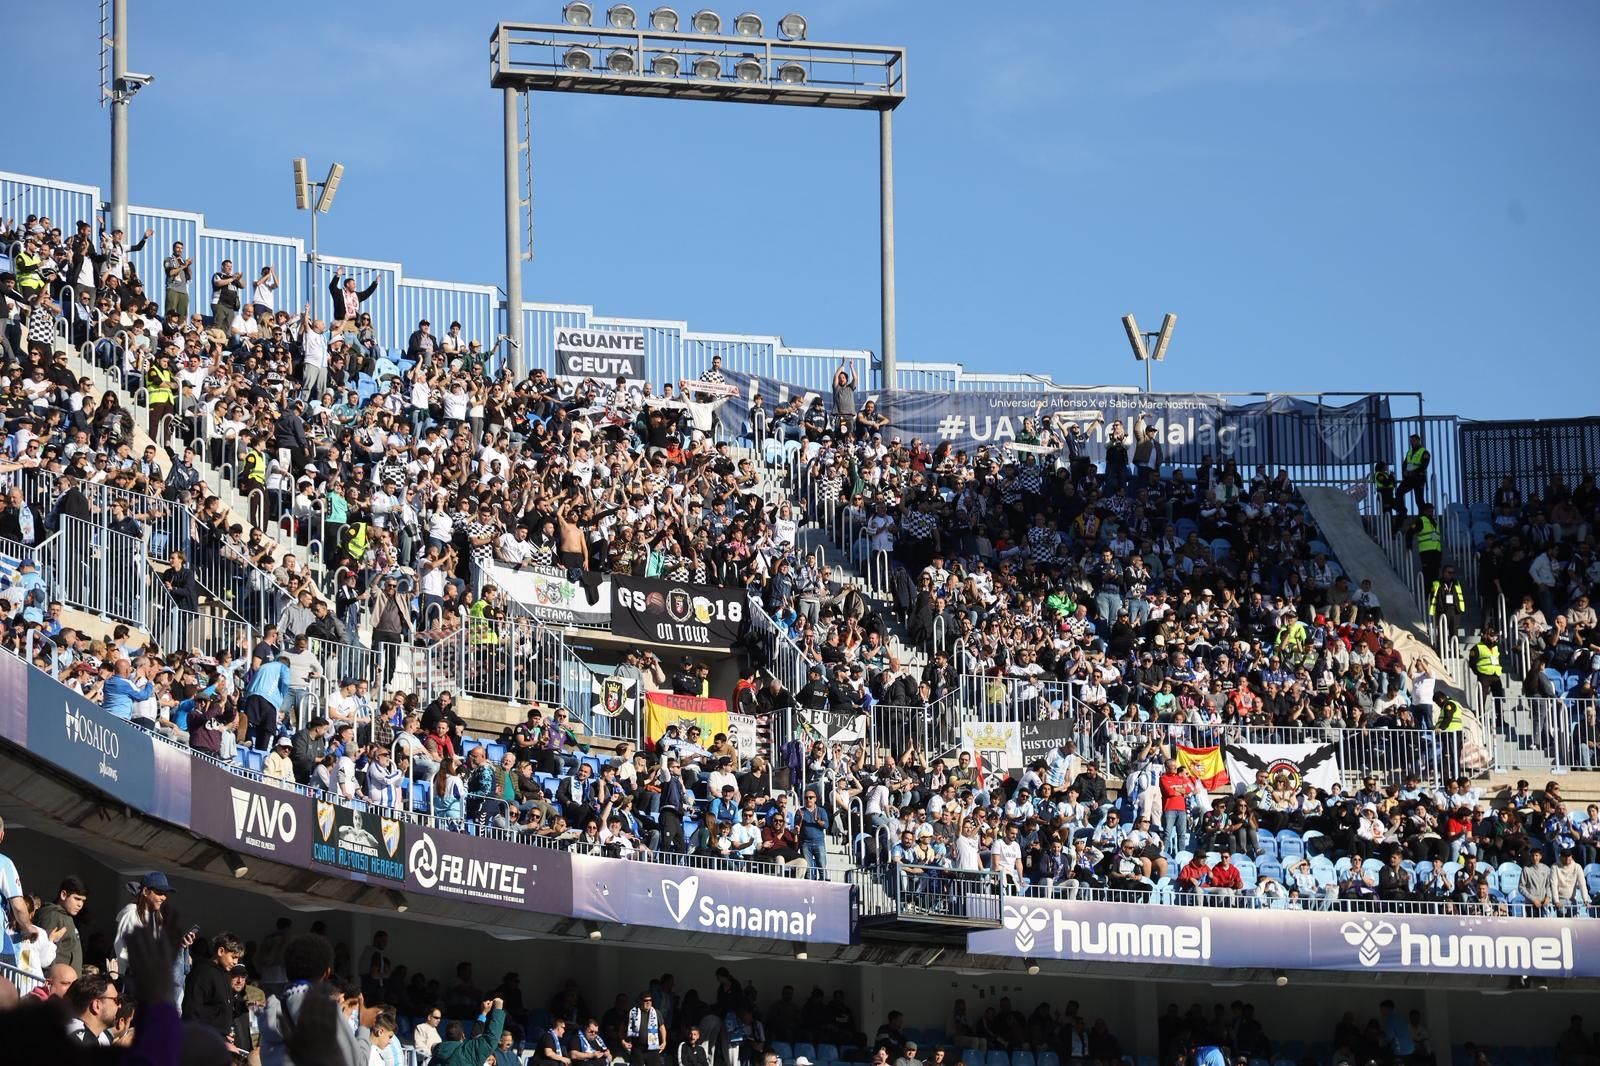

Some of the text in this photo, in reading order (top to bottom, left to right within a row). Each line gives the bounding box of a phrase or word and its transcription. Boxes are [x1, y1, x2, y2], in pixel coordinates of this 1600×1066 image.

[557, 332, 645, 350] AGUANTE
[568, 355, 634, 375] CEUTA
[1052, 398, 1088, 409] Alfonso
[1089, 399, 1097, 408] X
[1099, 398, 1107, 409] el
[1109, 399, 1137, 410] Sabio
[1139, 400, 1163, 410] Mare
[1165, 400, 1207, 410] Nostrum
[617, 587, 646, 612] GS
[535, 607, 574, 621] KETAMA
[716, 599, 742, 622] 18
[678, 625, 710, 643] TOUR
[666, 694, 709, 712] FRENTE
[65, 701, 119, 759] MOSAICO
[698, 895, 817, 936] Sanamar
[1053, 909, 1211, 960] hummel
[1401, 923, 1573, 970] hummel
